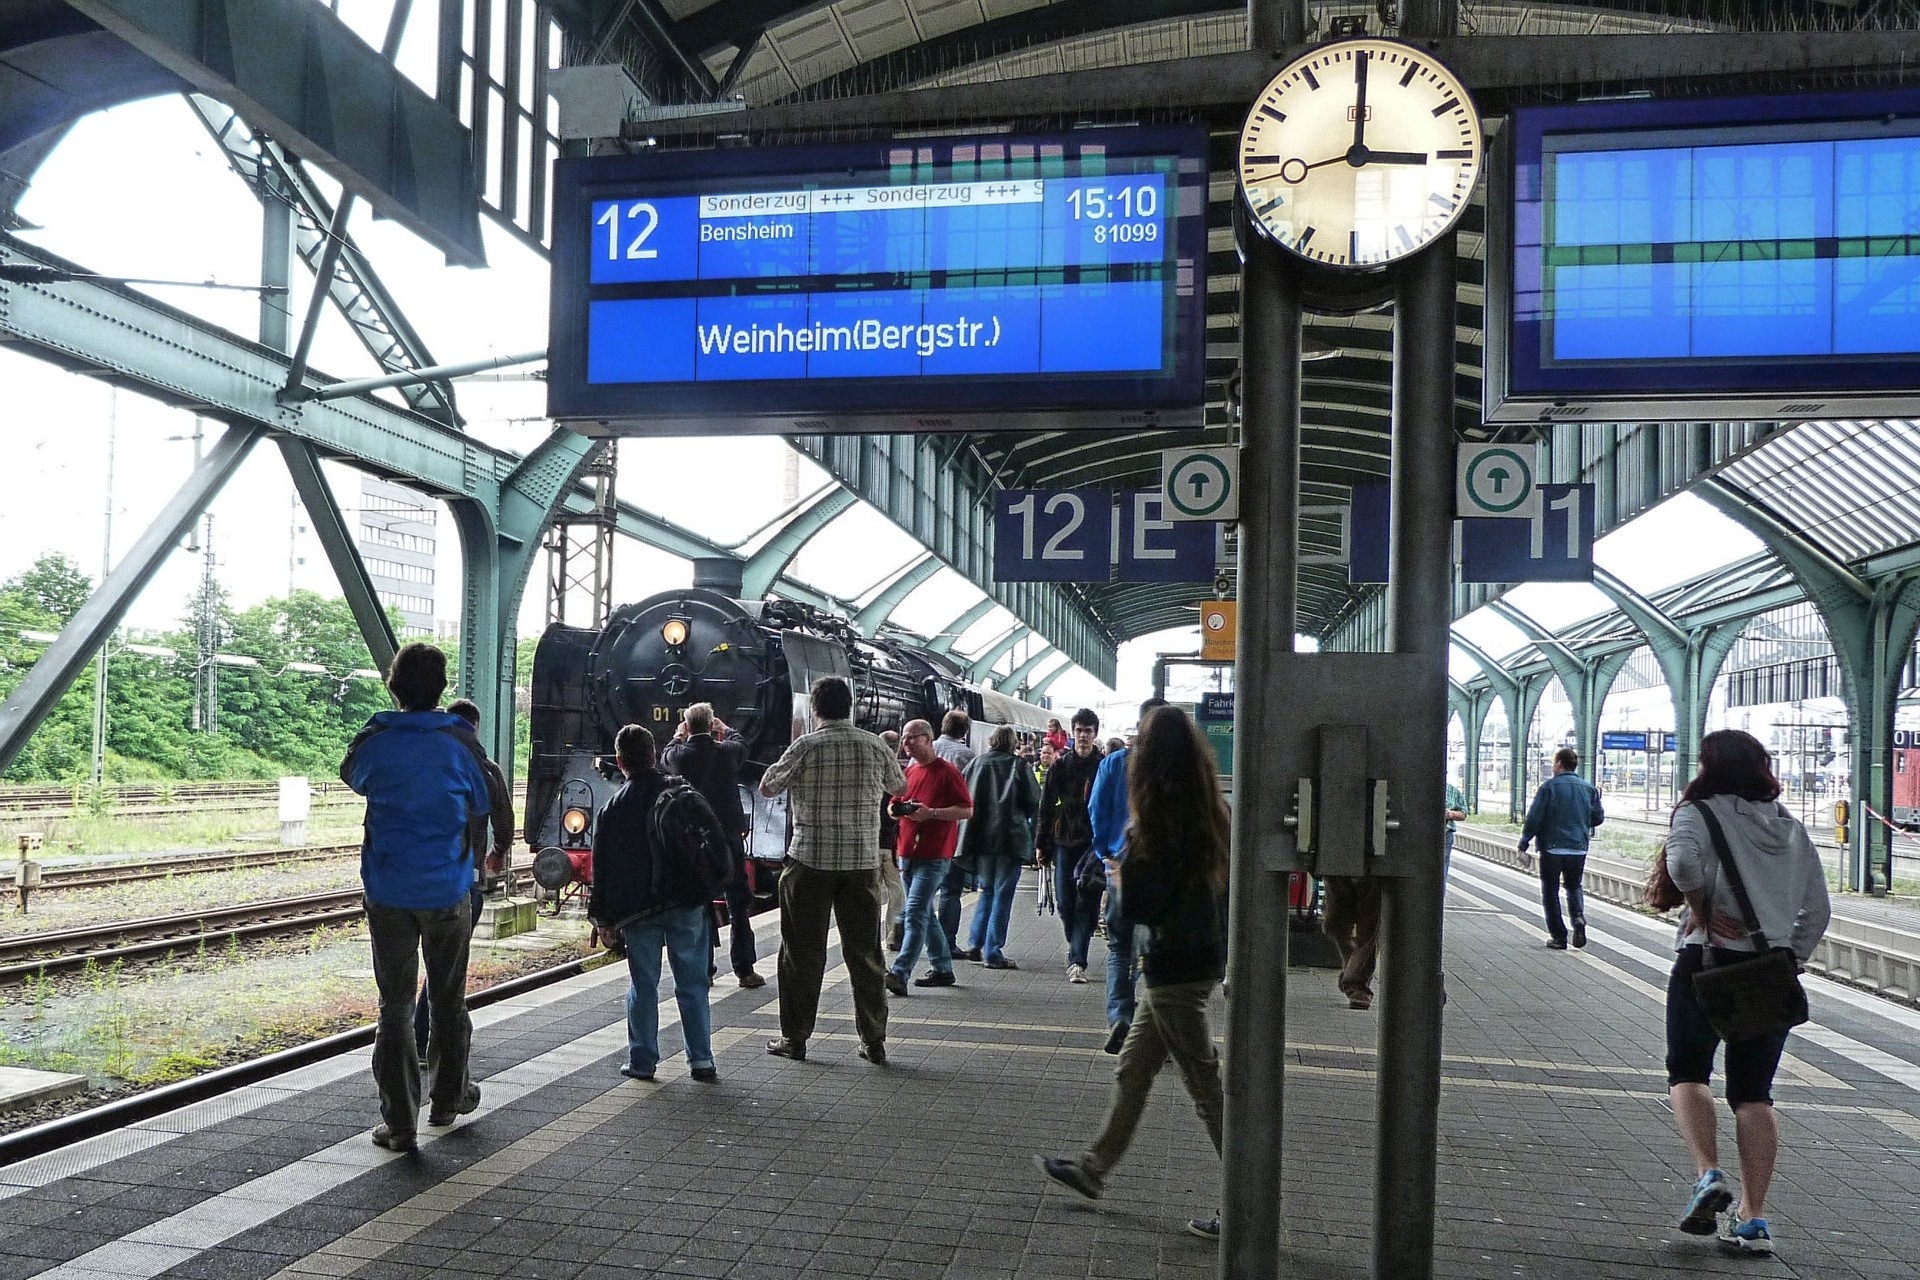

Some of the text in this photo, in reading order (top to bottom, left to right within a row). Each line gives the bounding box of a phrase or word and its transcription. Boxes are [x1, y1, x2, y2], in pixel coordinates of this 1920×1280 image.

[707, 193, 807, 212] Sonderzug
[820, 193, 855, 206] +++
[866, 185, 972, 204] Sonderzug
[984, 184, 1021, 198] +++
[1065, 185, 1157, 220] 15:10
[596, 202, 659, 261] 12
[700, 221, 794, 243] Bensheim
[1094, 222, 1158, 244] 81099
[698, 316, 1001, 357] Weinheim(Bergstr.)
[1008, 492, 1176, 560] 12 E
[1530, 488, 1580, 559] 11
[653, 707, 669, 722] 01
[1894, 730, 1905, 745] 0
